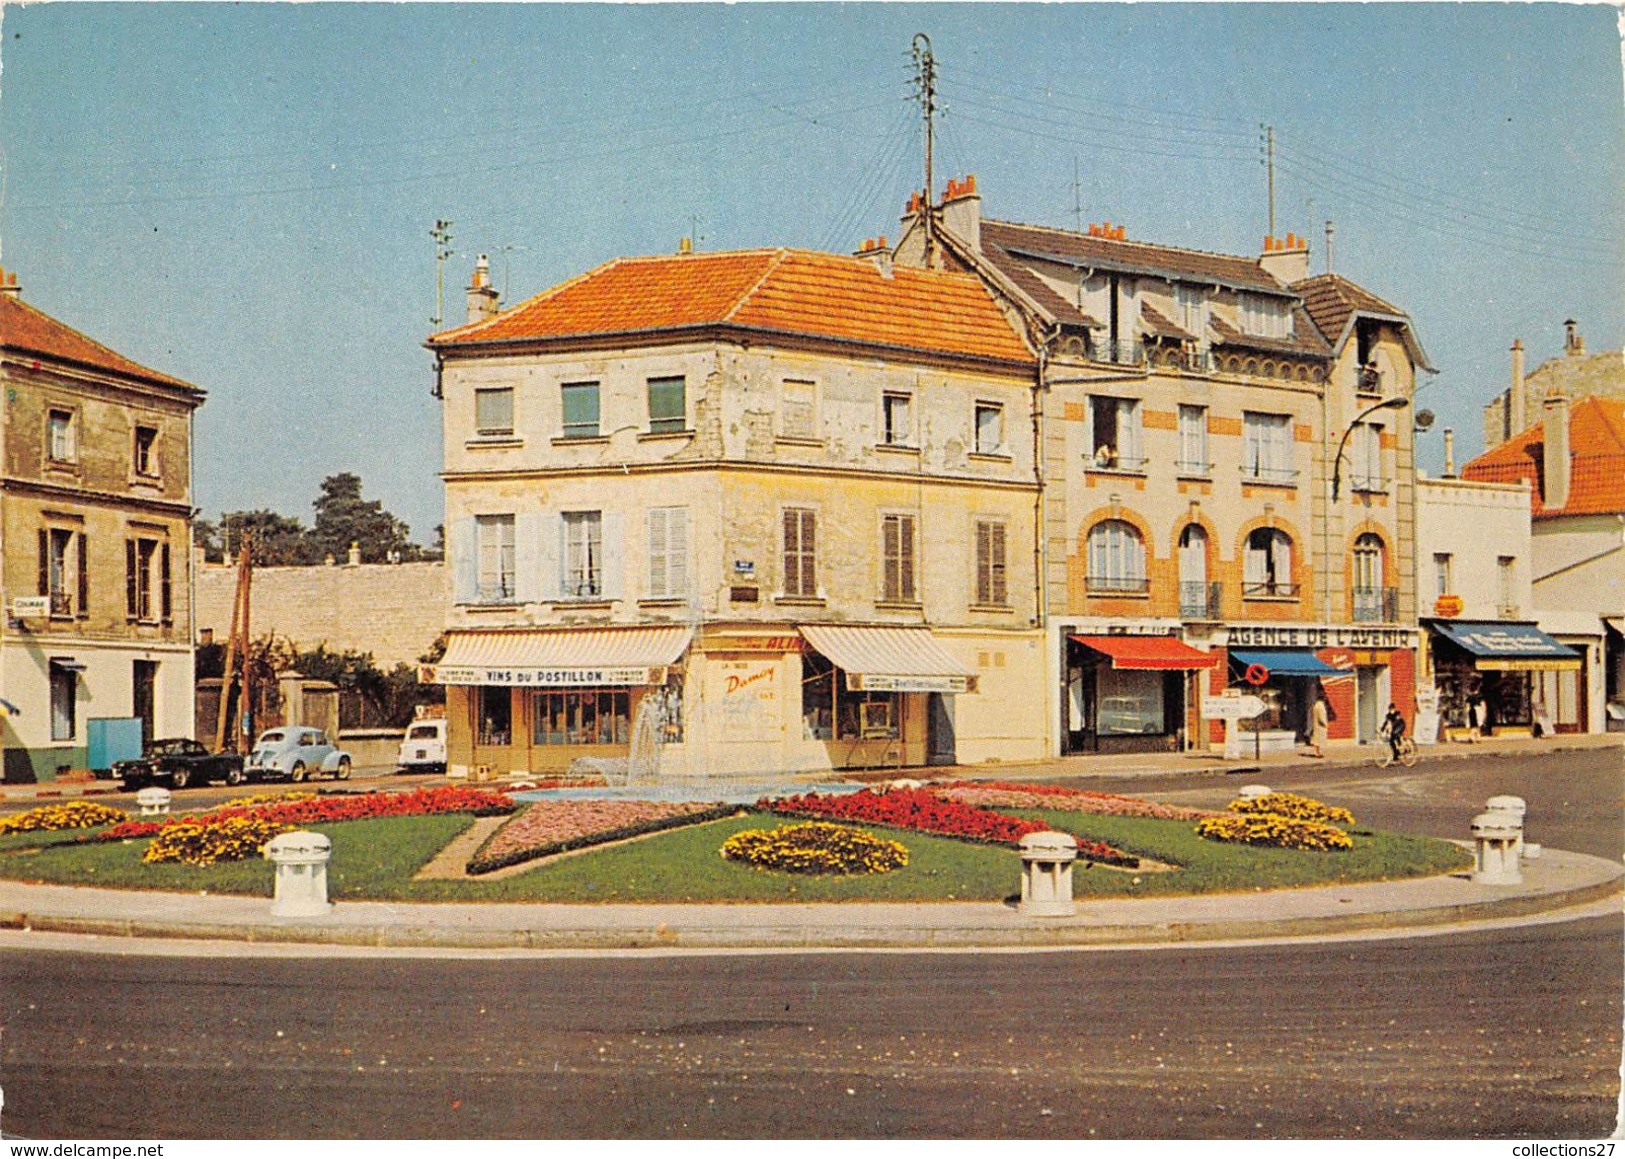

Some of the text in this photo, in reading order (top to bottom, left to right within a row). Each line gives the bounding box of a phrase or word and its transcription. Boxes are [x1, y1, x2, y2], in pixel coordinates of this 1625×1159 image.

[1226, 627, 1298, 645] AGENCE
[1307, 628, 1328, 645] DE
[487, 671, 511, 682] VINS
[517, 672, 532, 683] DU
[537, 671, 603, 683] POSTILLON
